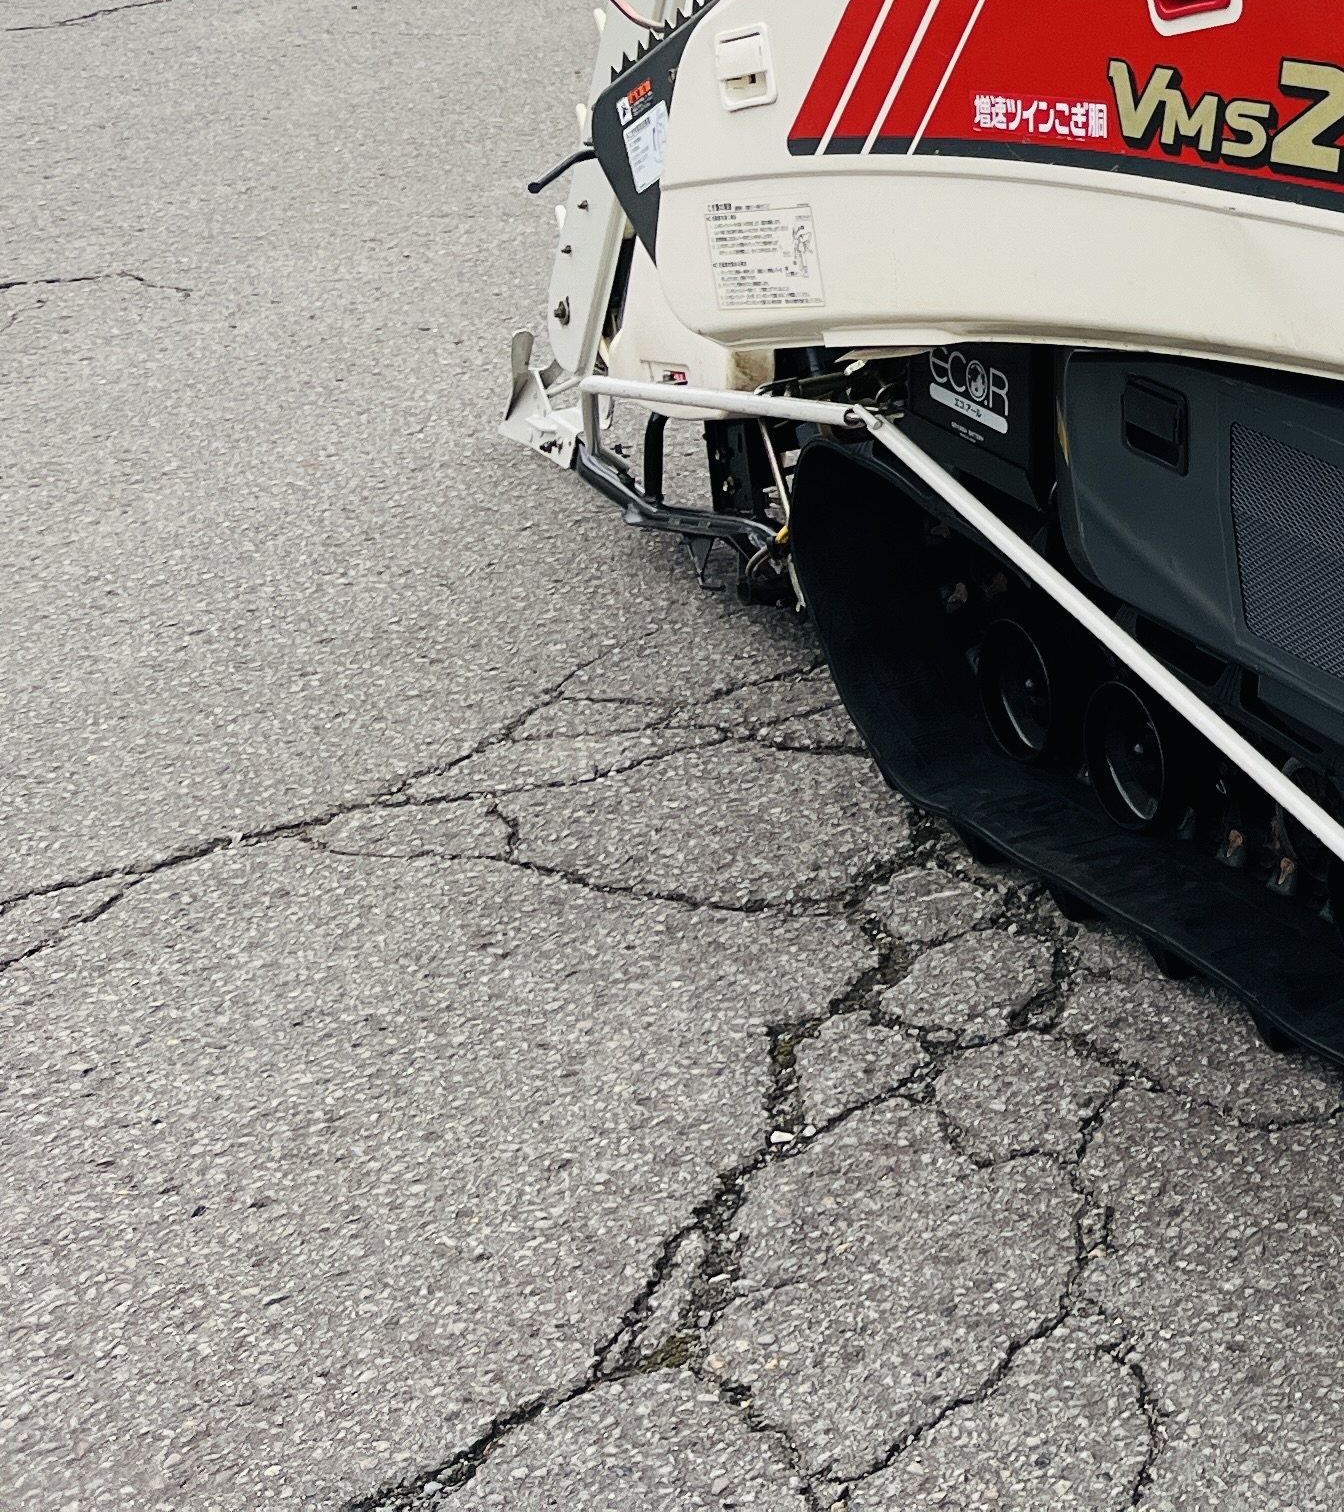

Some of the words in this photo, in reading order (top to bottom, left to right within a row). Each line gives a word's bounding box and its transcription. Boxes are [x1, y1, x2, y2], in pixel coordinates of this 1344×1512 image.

[973, 93, 1108, 139] 増速ツインこぎ胴
